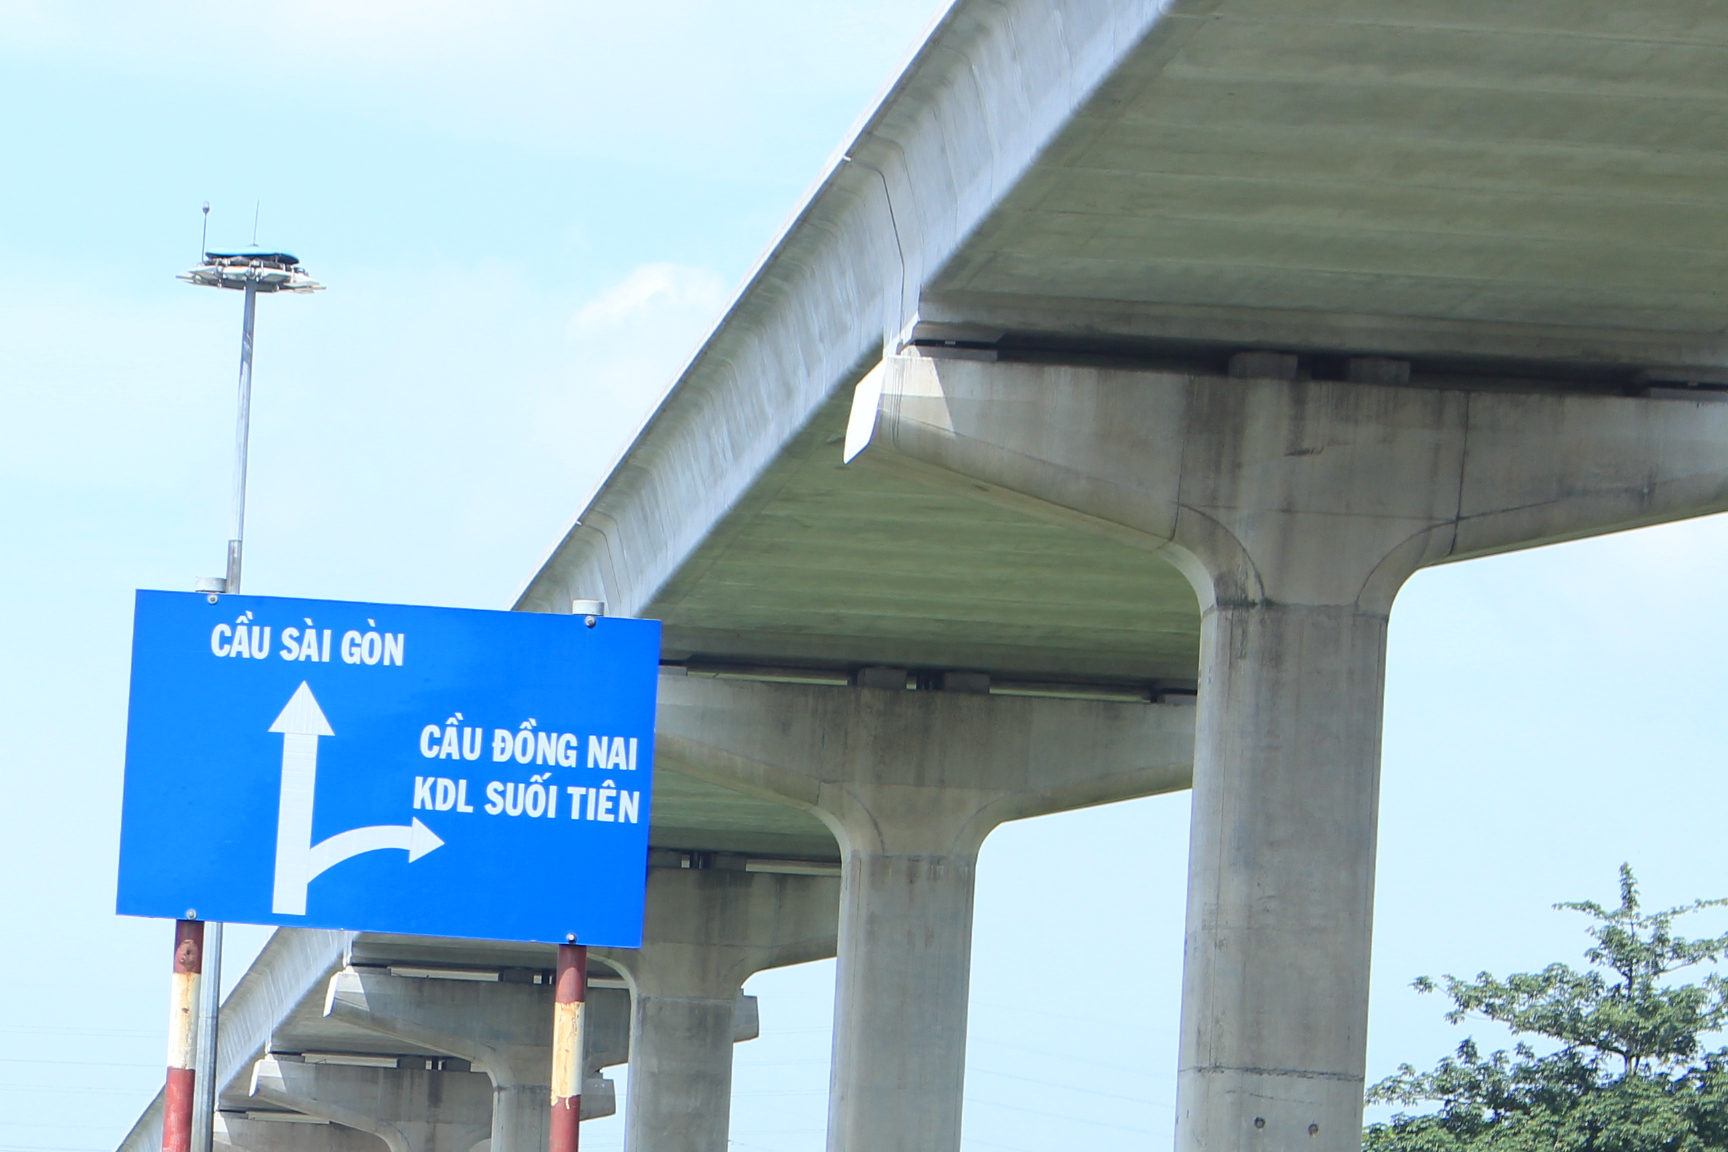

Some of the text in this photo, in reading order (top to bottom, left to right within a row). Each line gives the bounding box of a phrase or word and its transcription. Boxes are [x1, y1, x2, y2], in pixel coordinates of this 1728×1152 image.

[210, 610, 405, 667] CẦU SÀI GÒN
[419, 712, 638, 771] CẦU ĐỒNG NAI
[413, 772, 640, 824] KDL SUỐI TIÊN
